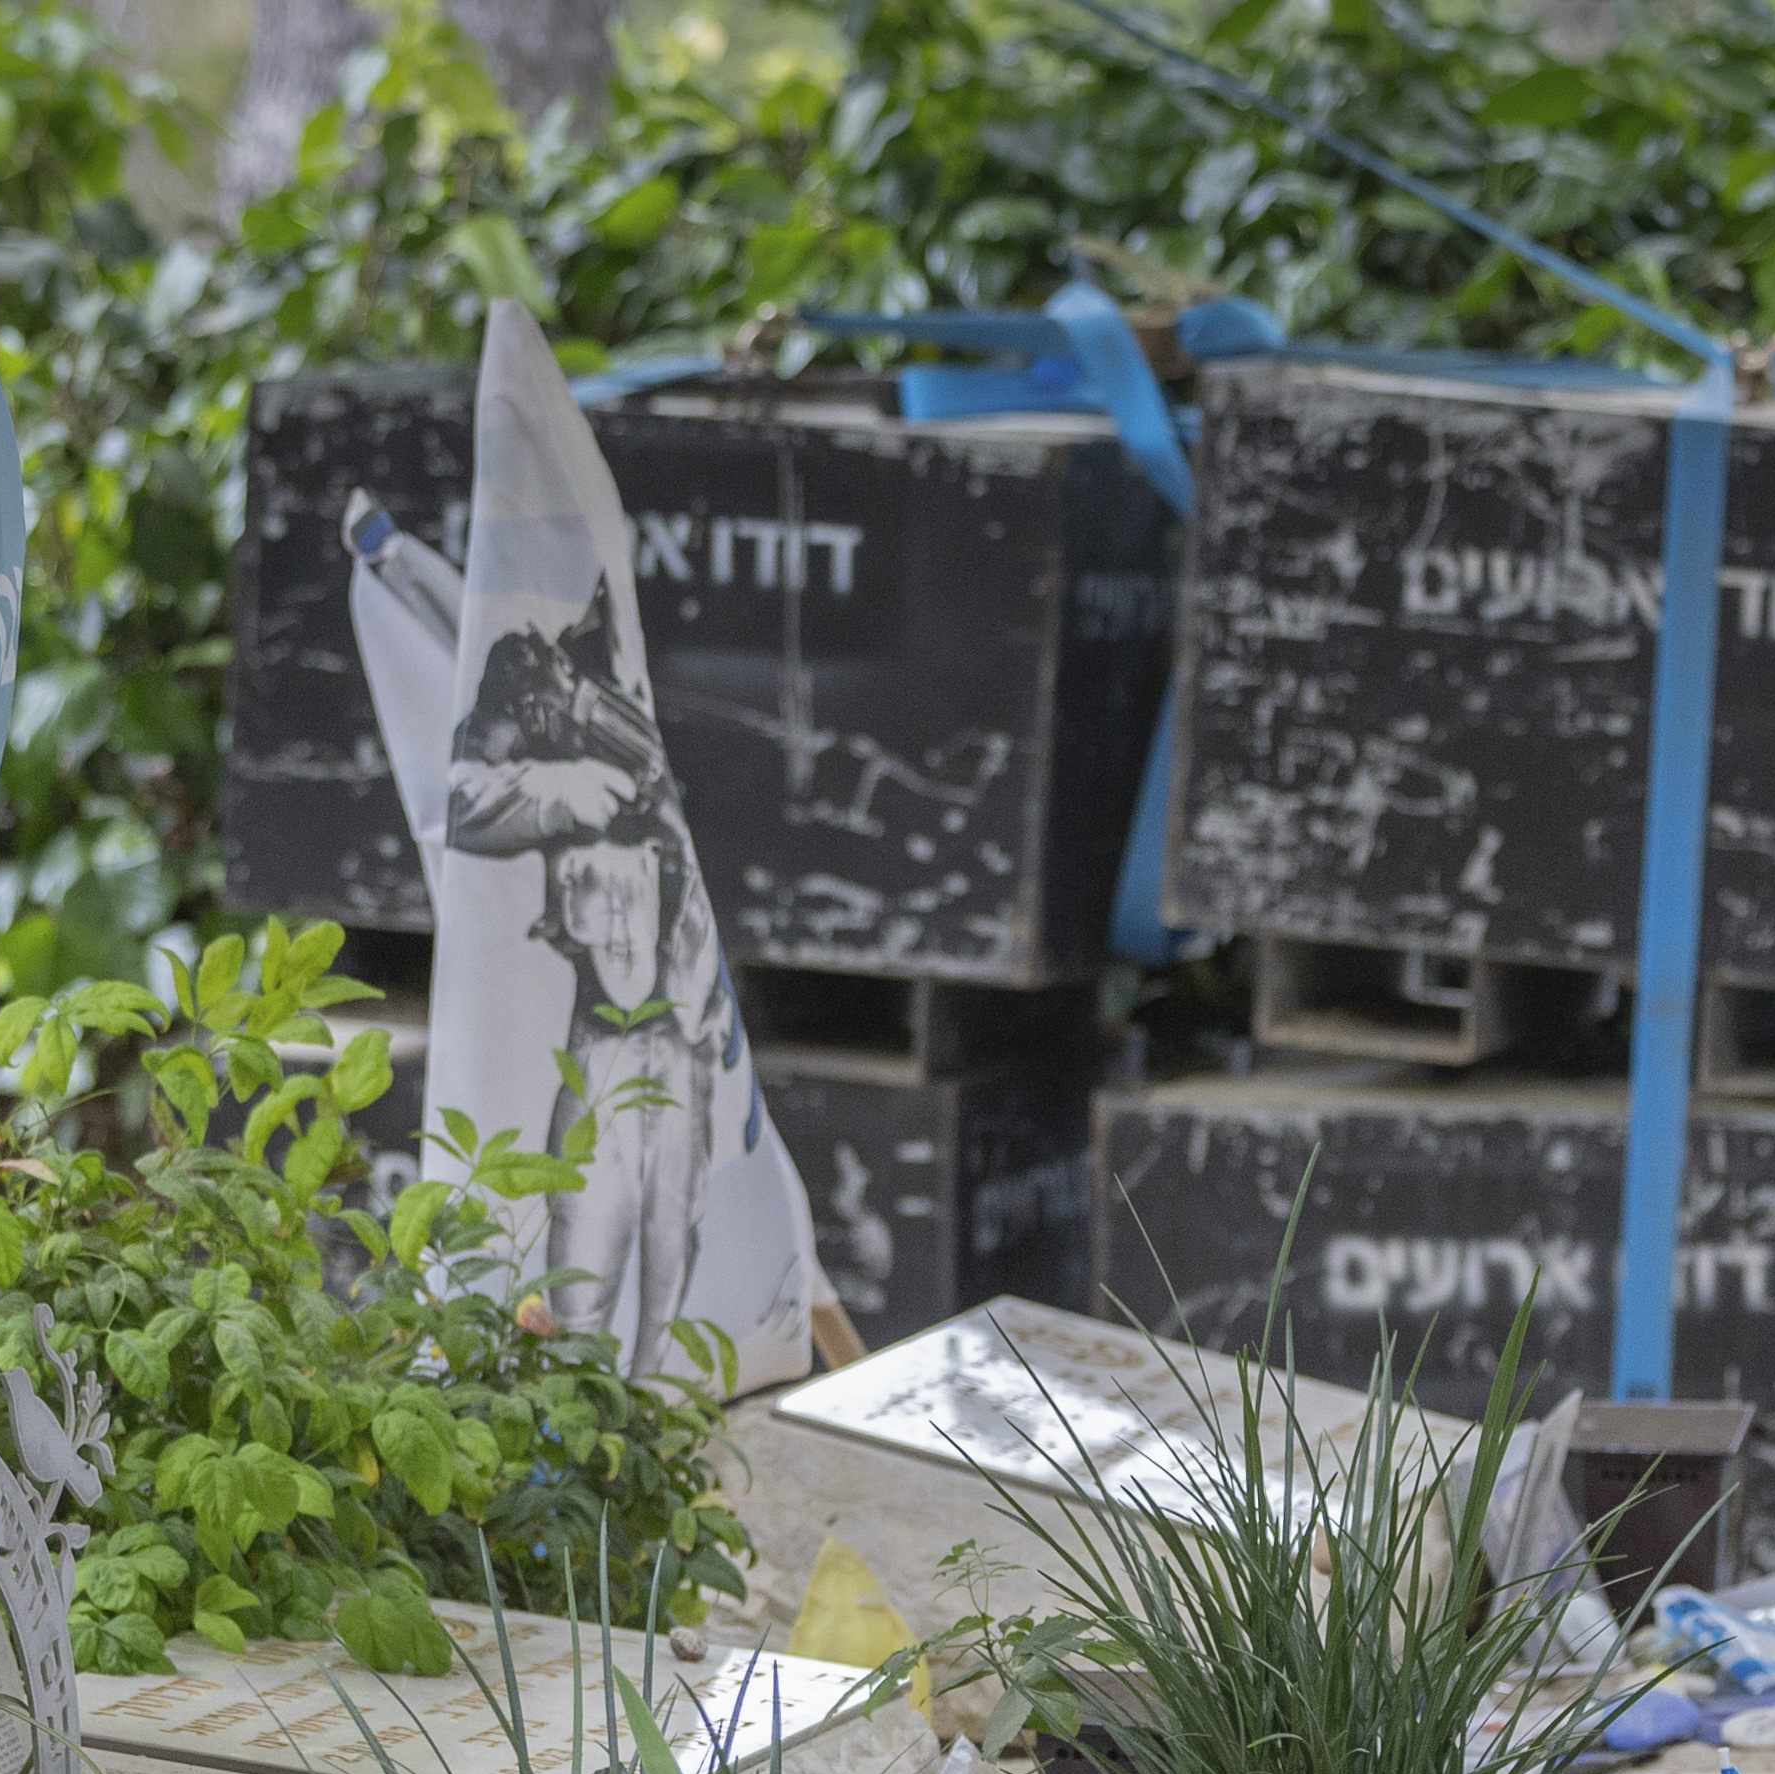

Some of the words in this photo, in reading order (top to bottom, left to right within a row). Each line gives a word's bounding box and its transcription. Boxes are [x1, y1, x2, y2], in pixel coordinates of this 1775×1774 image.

[711, 516, 864, 596] דודו
[1325, 1234, 1594, 1313] ארועים
[90, 1676, 223, 1721] סלוטקי
